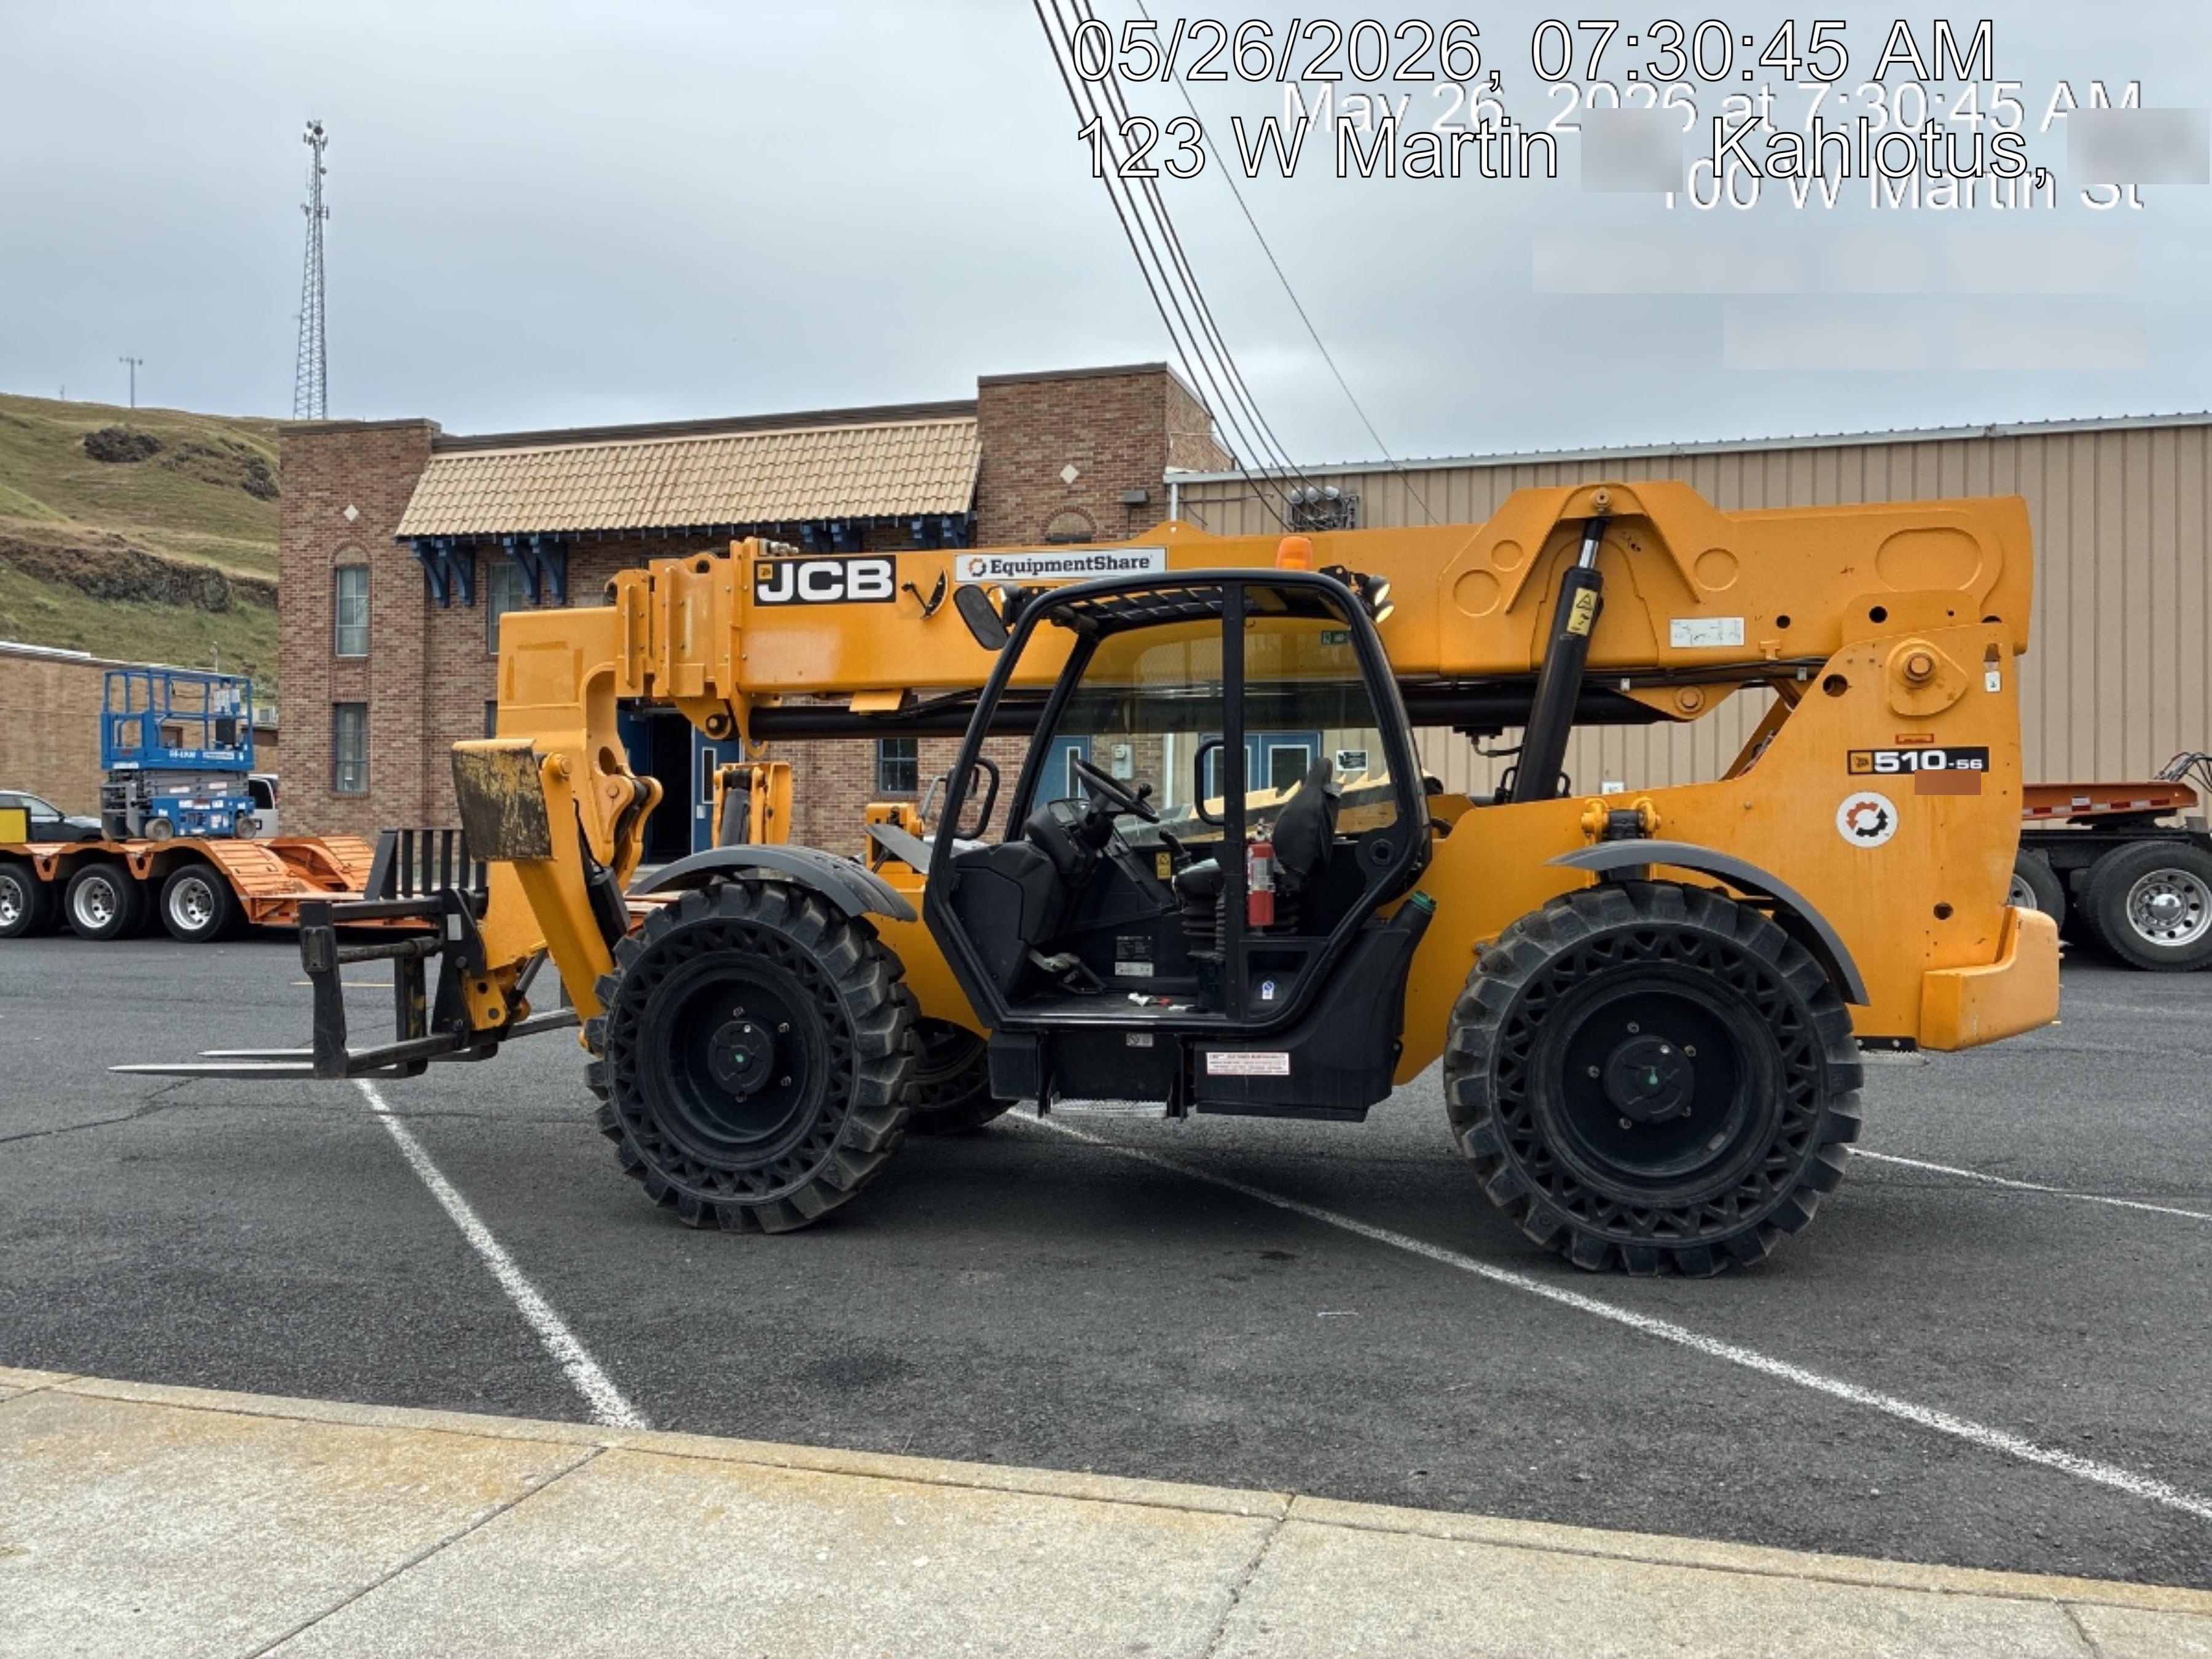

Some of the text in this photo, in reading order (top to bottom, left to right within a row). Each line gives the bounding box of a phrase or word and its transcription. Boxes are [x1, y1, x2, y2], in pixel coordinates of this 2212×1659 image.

[990, 555, 1150, 576] EquipmentShare
[757, 559, 893, 602] JCB
[1874, 750, 1983, 773] 510-56
